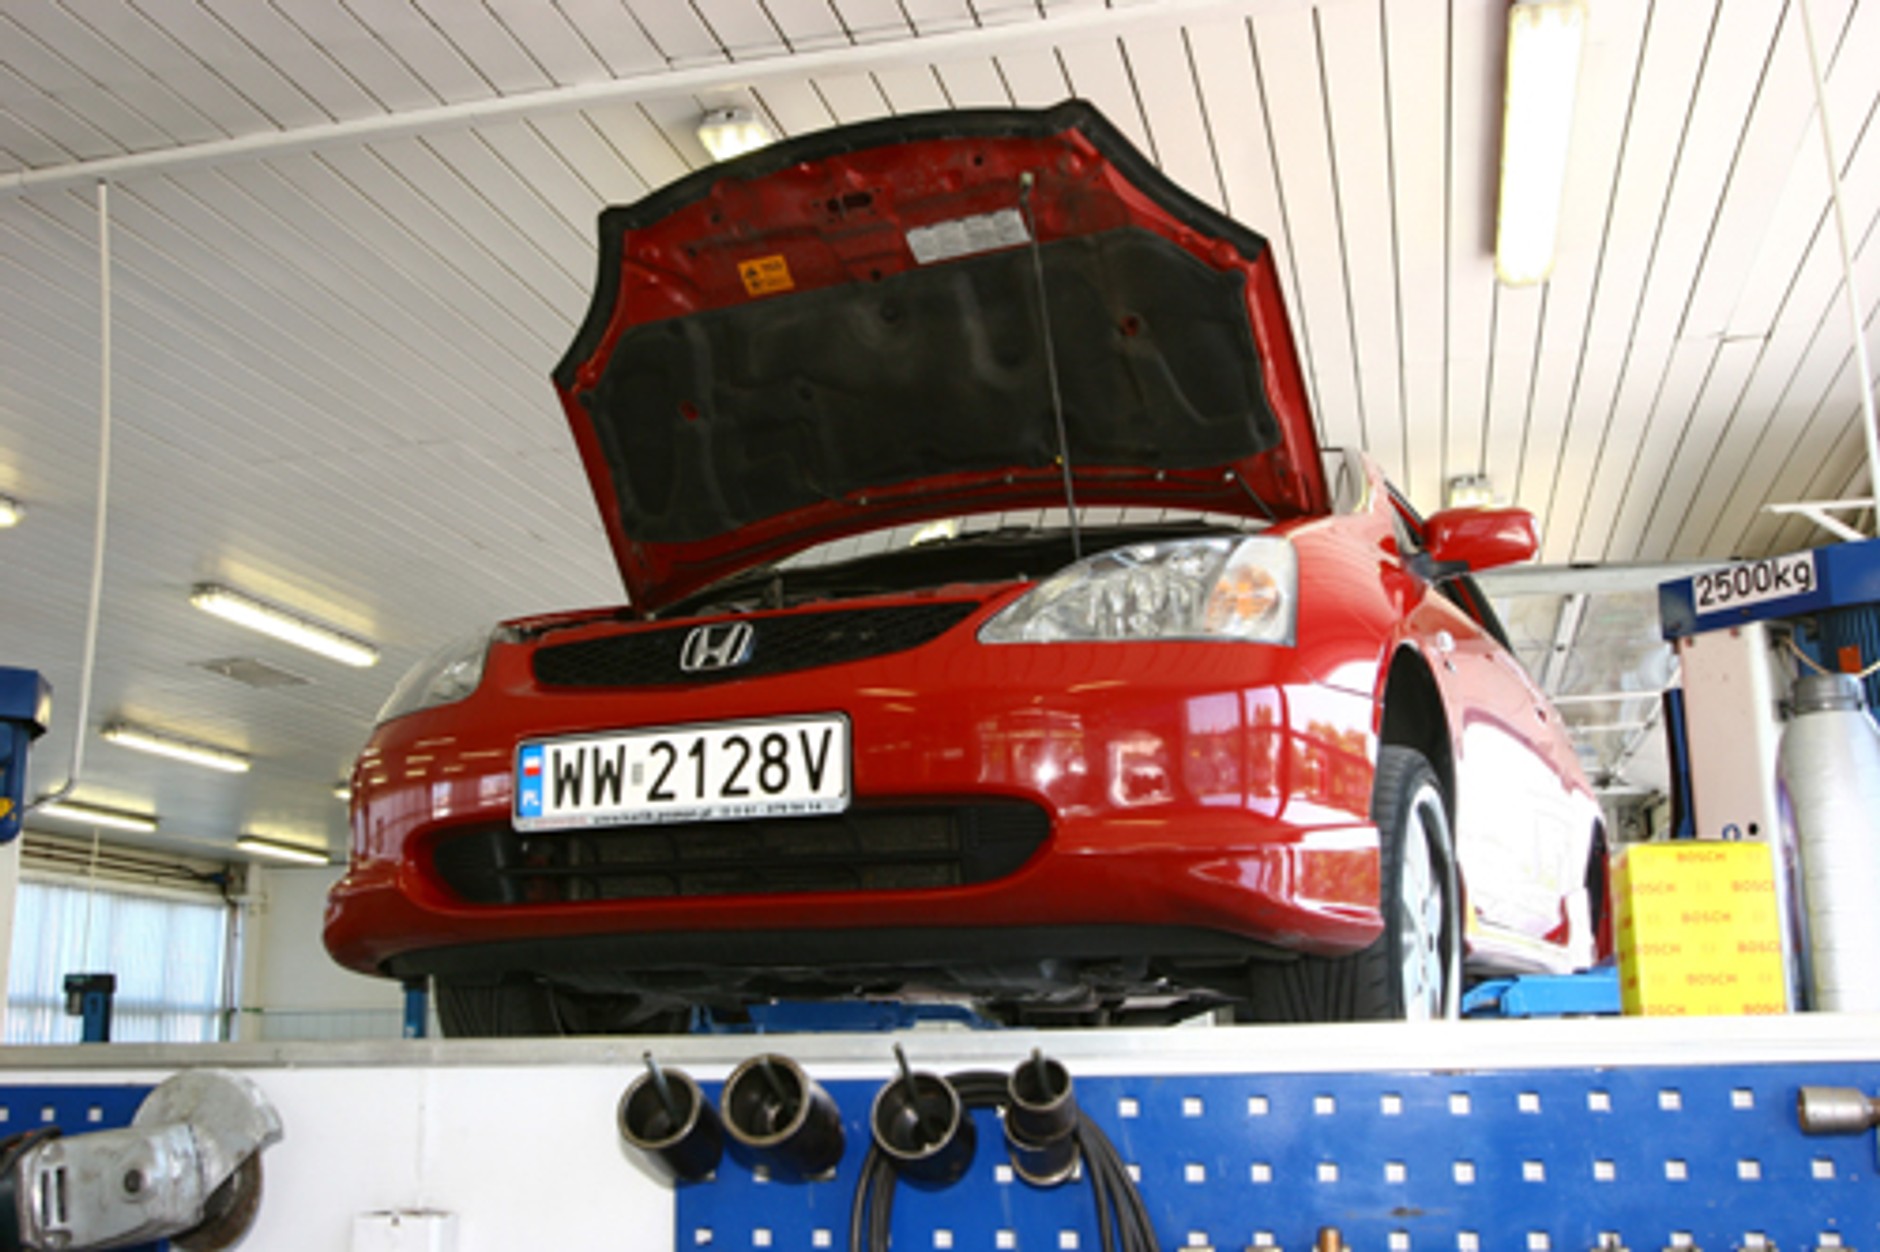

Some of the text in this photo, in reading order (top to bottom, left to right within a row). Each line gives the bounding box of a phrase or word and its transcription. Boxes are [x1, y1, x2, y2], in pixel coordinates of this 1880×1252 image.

[1697, 559, 1812, 606] 2500kg
[553, 728, 832, 809] WW 2128V
[1676, 852, 1726, 864] BOSCH
[1681, 911, 1732, 924] BOSCH
[1686, 973, 1738, 986] BOSCH
